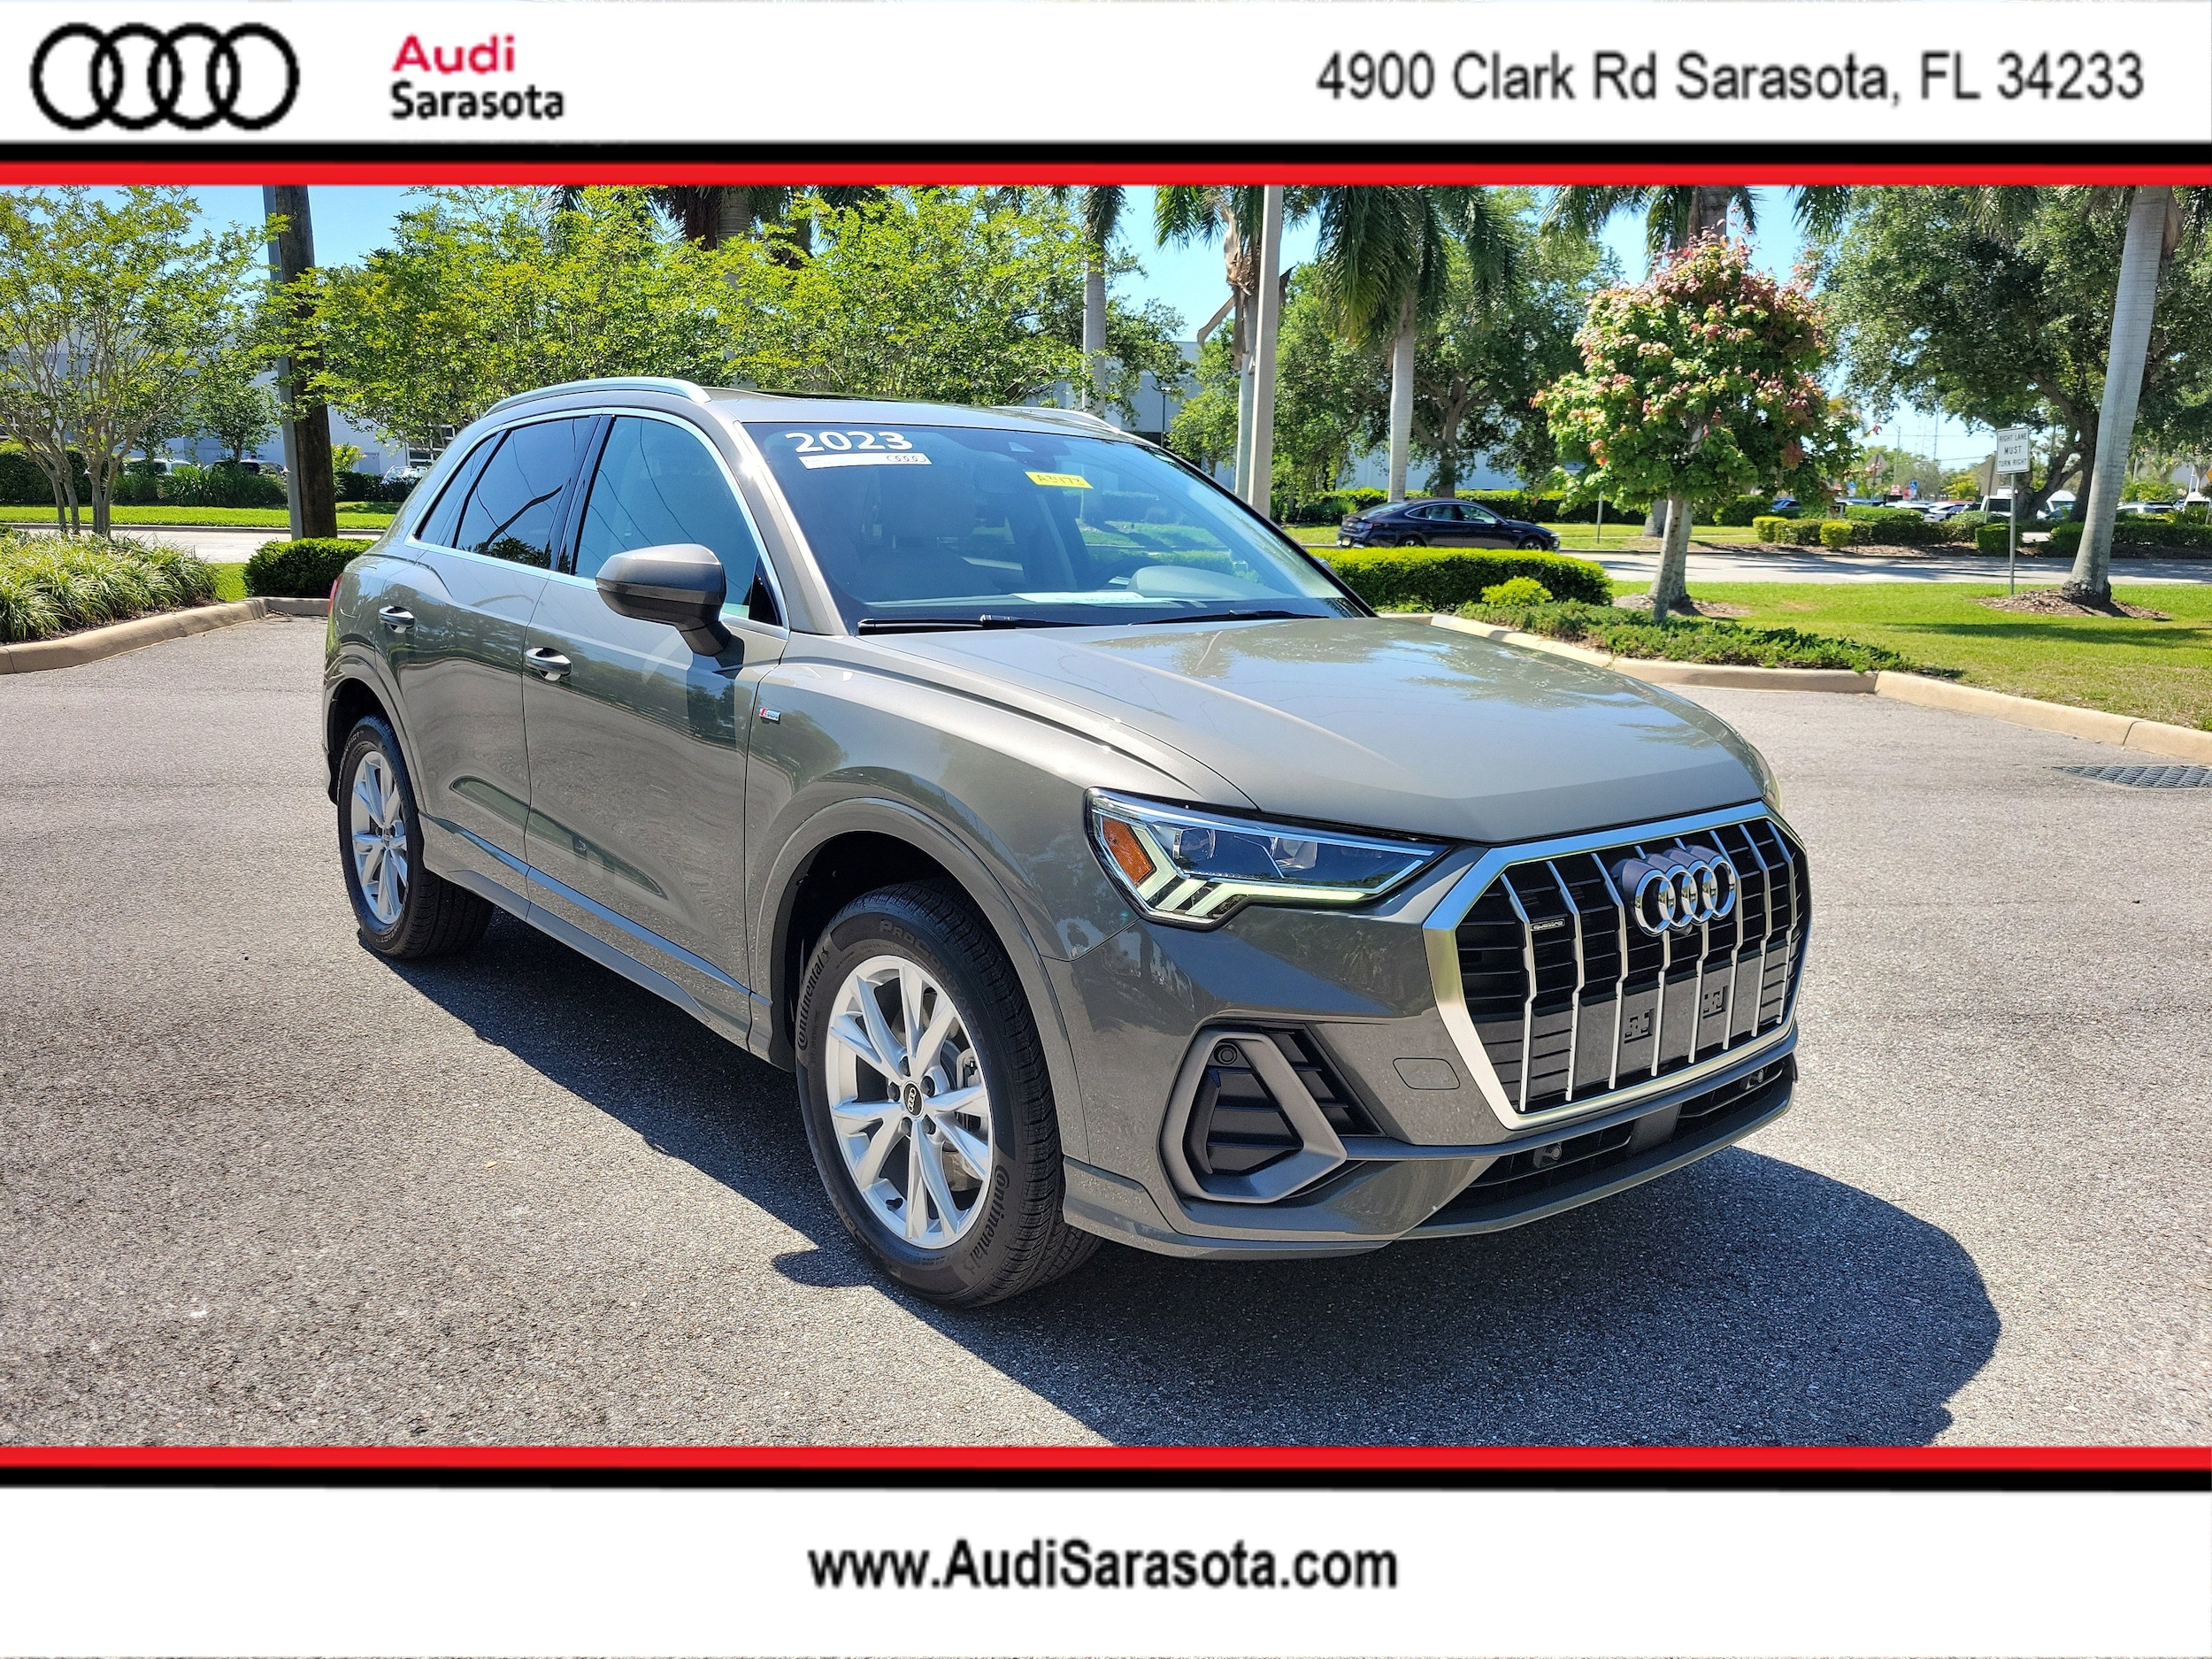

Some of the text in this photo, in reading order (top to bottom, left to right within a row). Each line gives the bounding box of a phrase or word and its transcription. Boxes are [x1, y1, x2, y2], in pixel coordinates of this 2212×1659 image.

[785, 431, 913, 452] 2023
[2004, 445, 2022, 455] MUST
[2013, 457, 2027, 466] RIGHT
[797, 954, 825, 1051] Continental
[970, 1164, 1010, 1269] Continental
